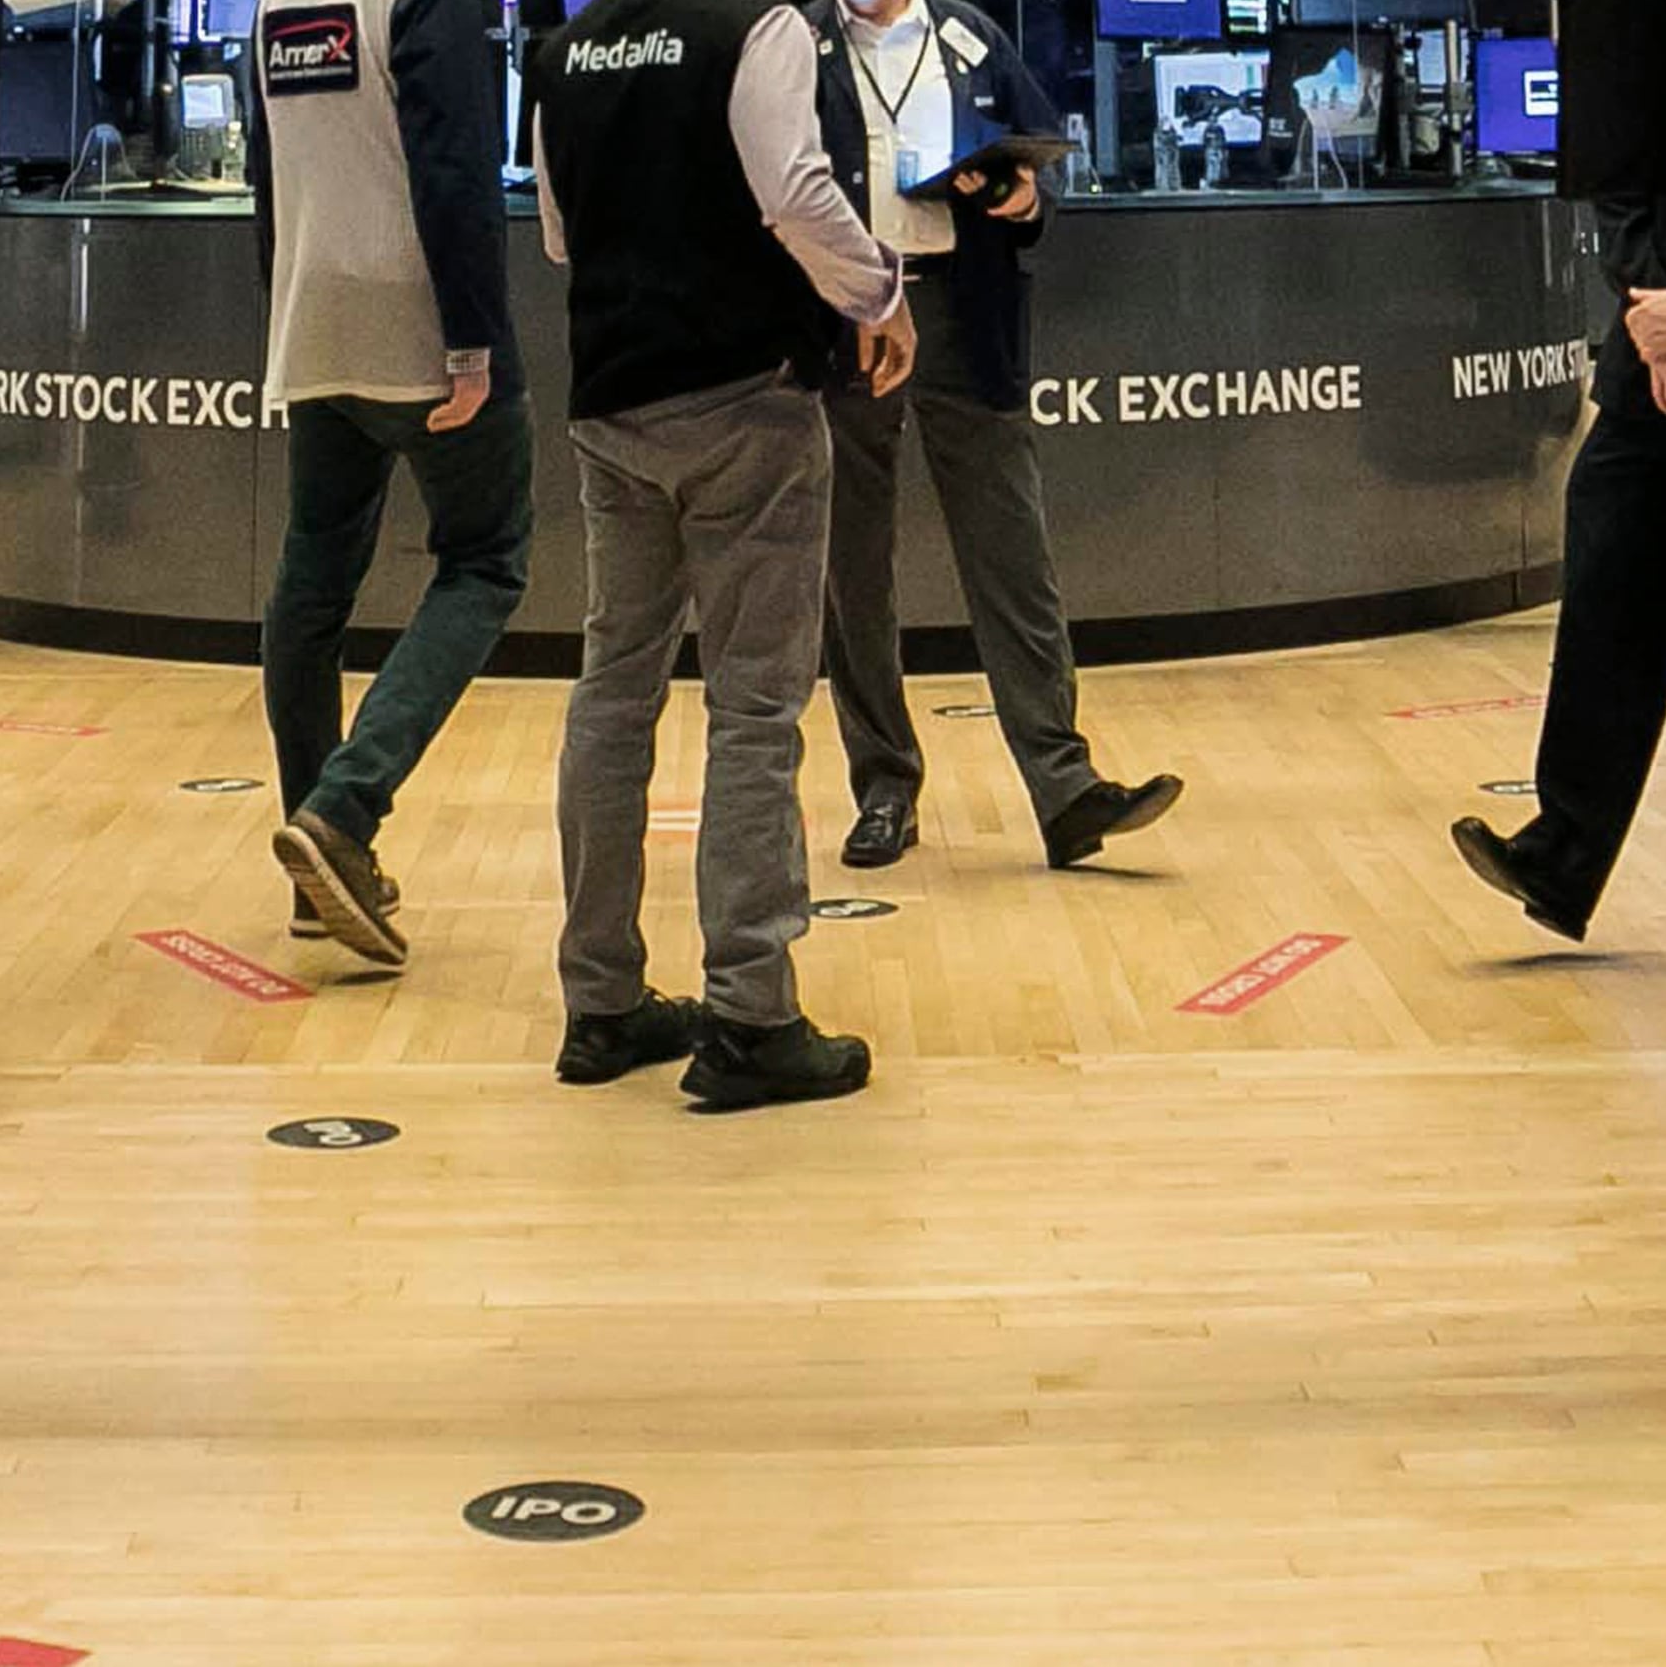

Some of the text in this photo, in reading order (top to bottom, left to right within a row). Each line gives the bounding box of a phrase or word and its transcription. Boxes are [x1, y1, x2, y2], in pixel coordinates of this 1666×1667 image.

[564, 31, 684, 75] Medallia
[1118, 364, 1362, 424] EXCHANGE
[1452, 350, 1512, 400] NEW
[1517, 342, 1567, 391] YORK
[33, 372, 159, 426] STOCK
[490, 1494, 618, 1526] IPO
